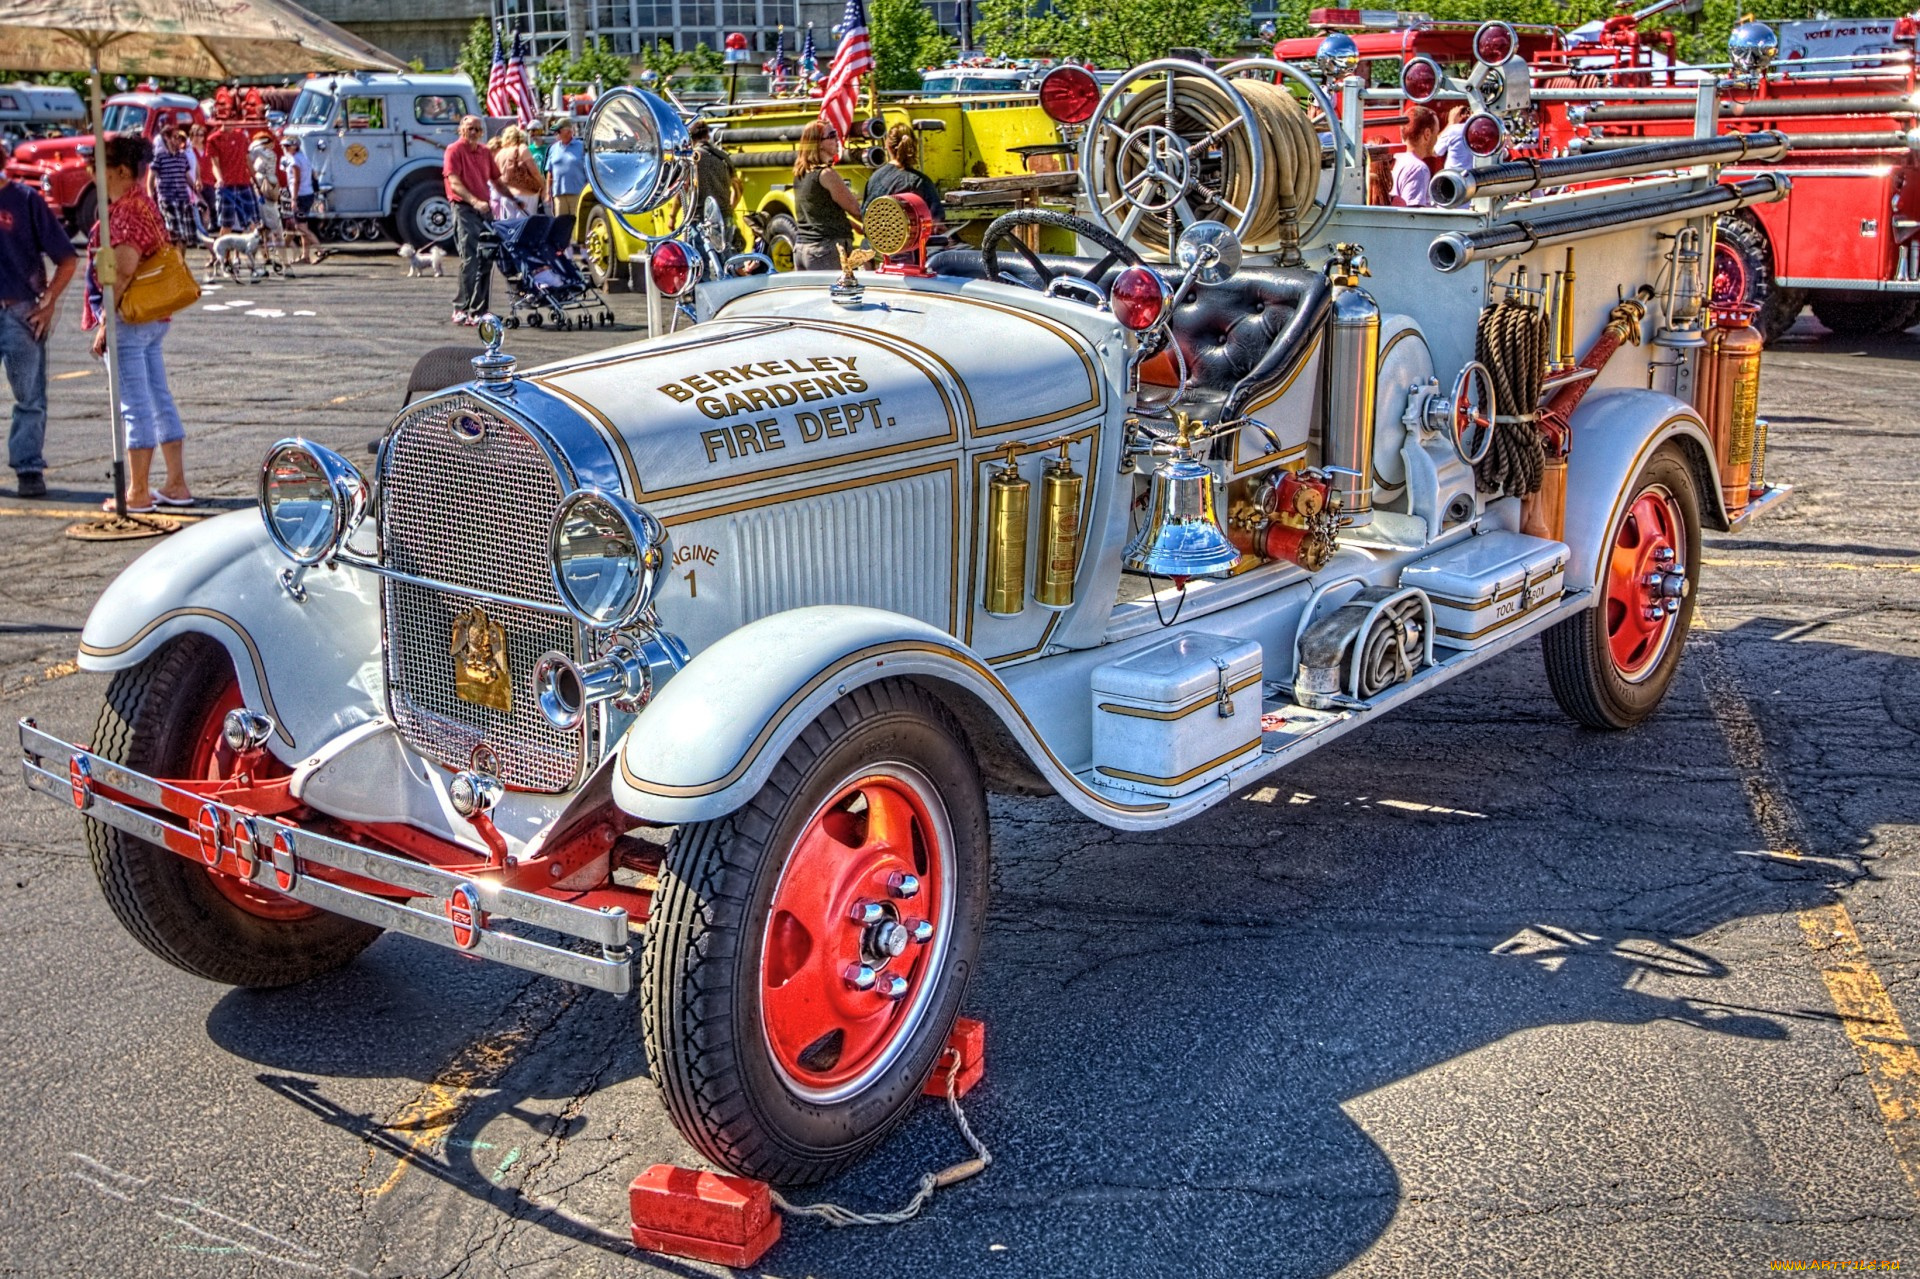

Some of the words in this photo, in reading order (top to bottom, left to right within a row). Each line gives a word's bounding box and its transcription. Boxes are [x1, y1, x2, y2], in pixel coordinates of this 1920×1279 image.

[1804, 29, 1832, 40] VOTE
[1835, 27, 1857, 38] FOR
[657, 356, 857, 402] BERKELEY
[696, 372, 868, 419] GARDENS
[701, 418, 785, 463] FIRE
[795, 398, 896, 443] DEPT.
[671, 545, 719, 570] NGINE
[684, 569, 697, 598] 1
[1497, 602, 1515, 618] TOOL
